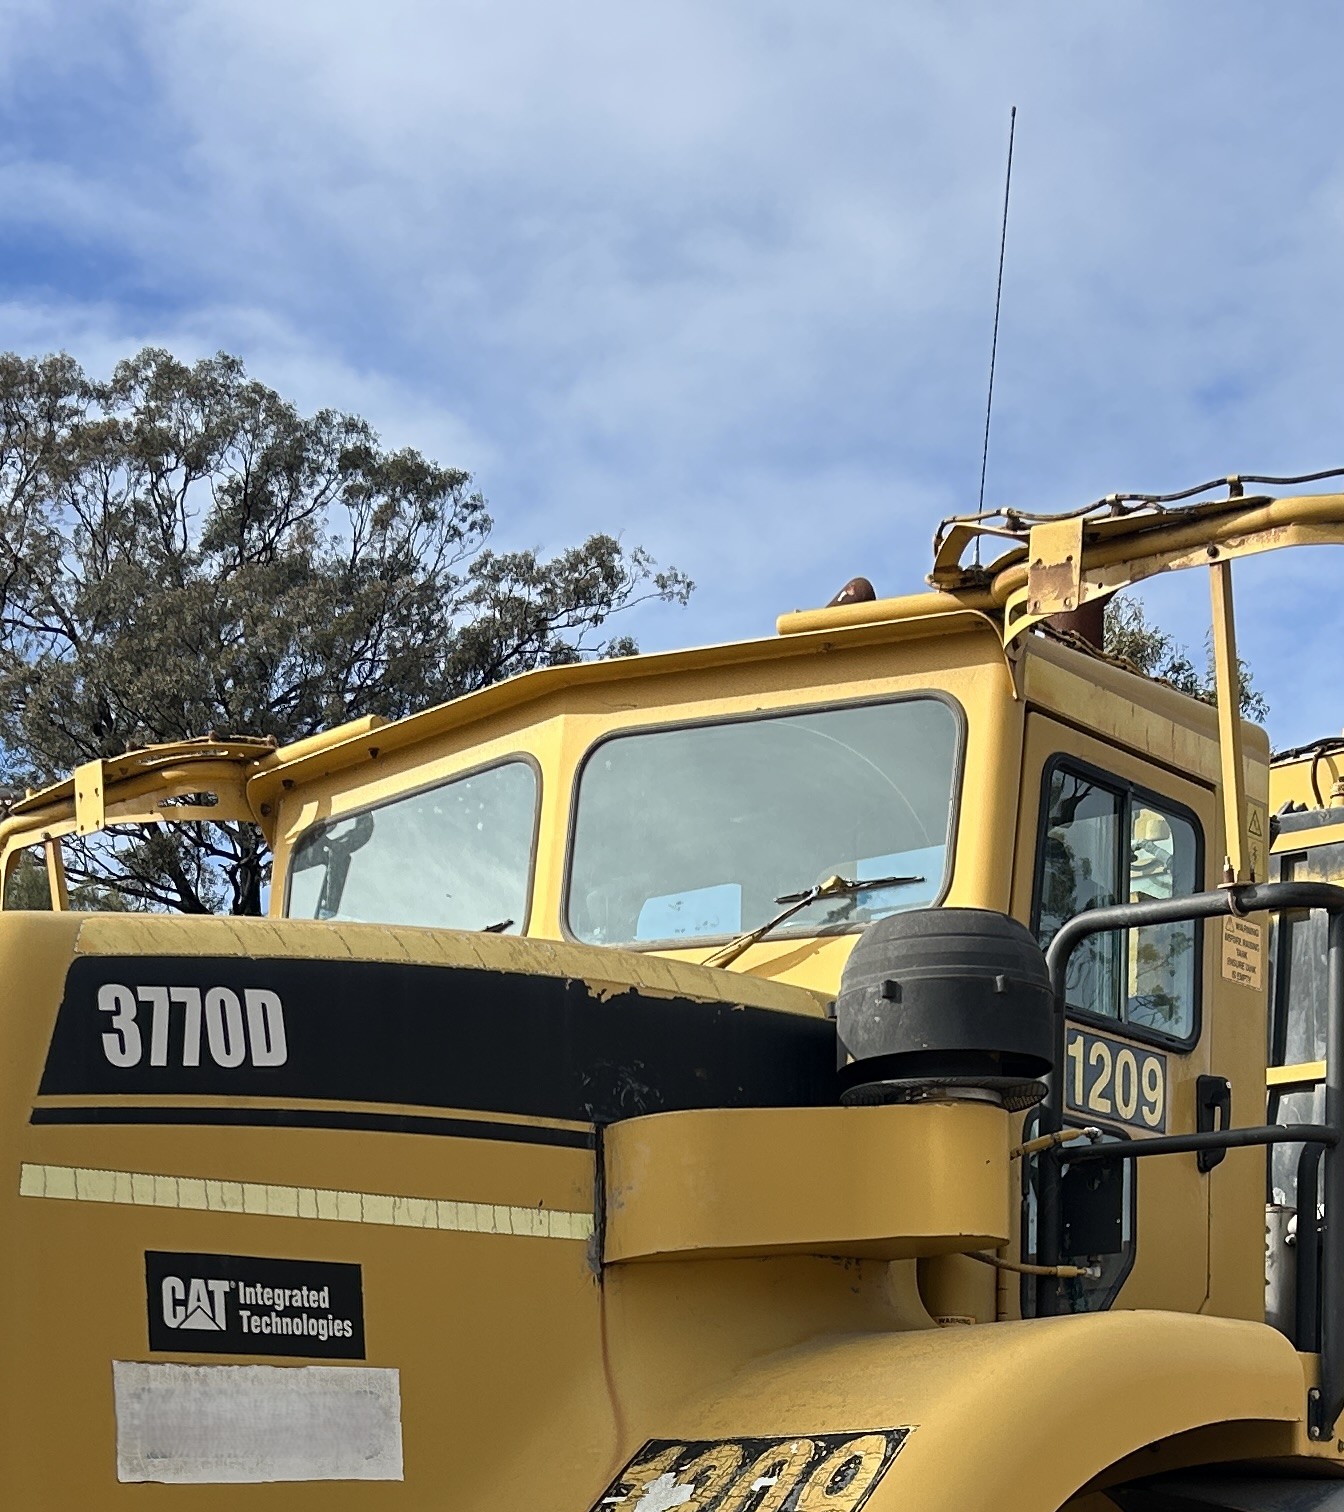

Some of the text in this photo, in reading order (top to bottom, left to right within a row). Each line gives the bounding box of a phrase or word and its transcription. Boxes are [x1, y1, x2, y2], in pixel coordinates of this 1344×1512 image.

[98, 983, 288, 1068] 3770D
[1068, 1035, 1164, 1127] 1209
[161, 1276, 231, 1331] CAT
[238, 1281, 330, 1311] Integrated
[238, 1310, 353, 1341] Technologies
